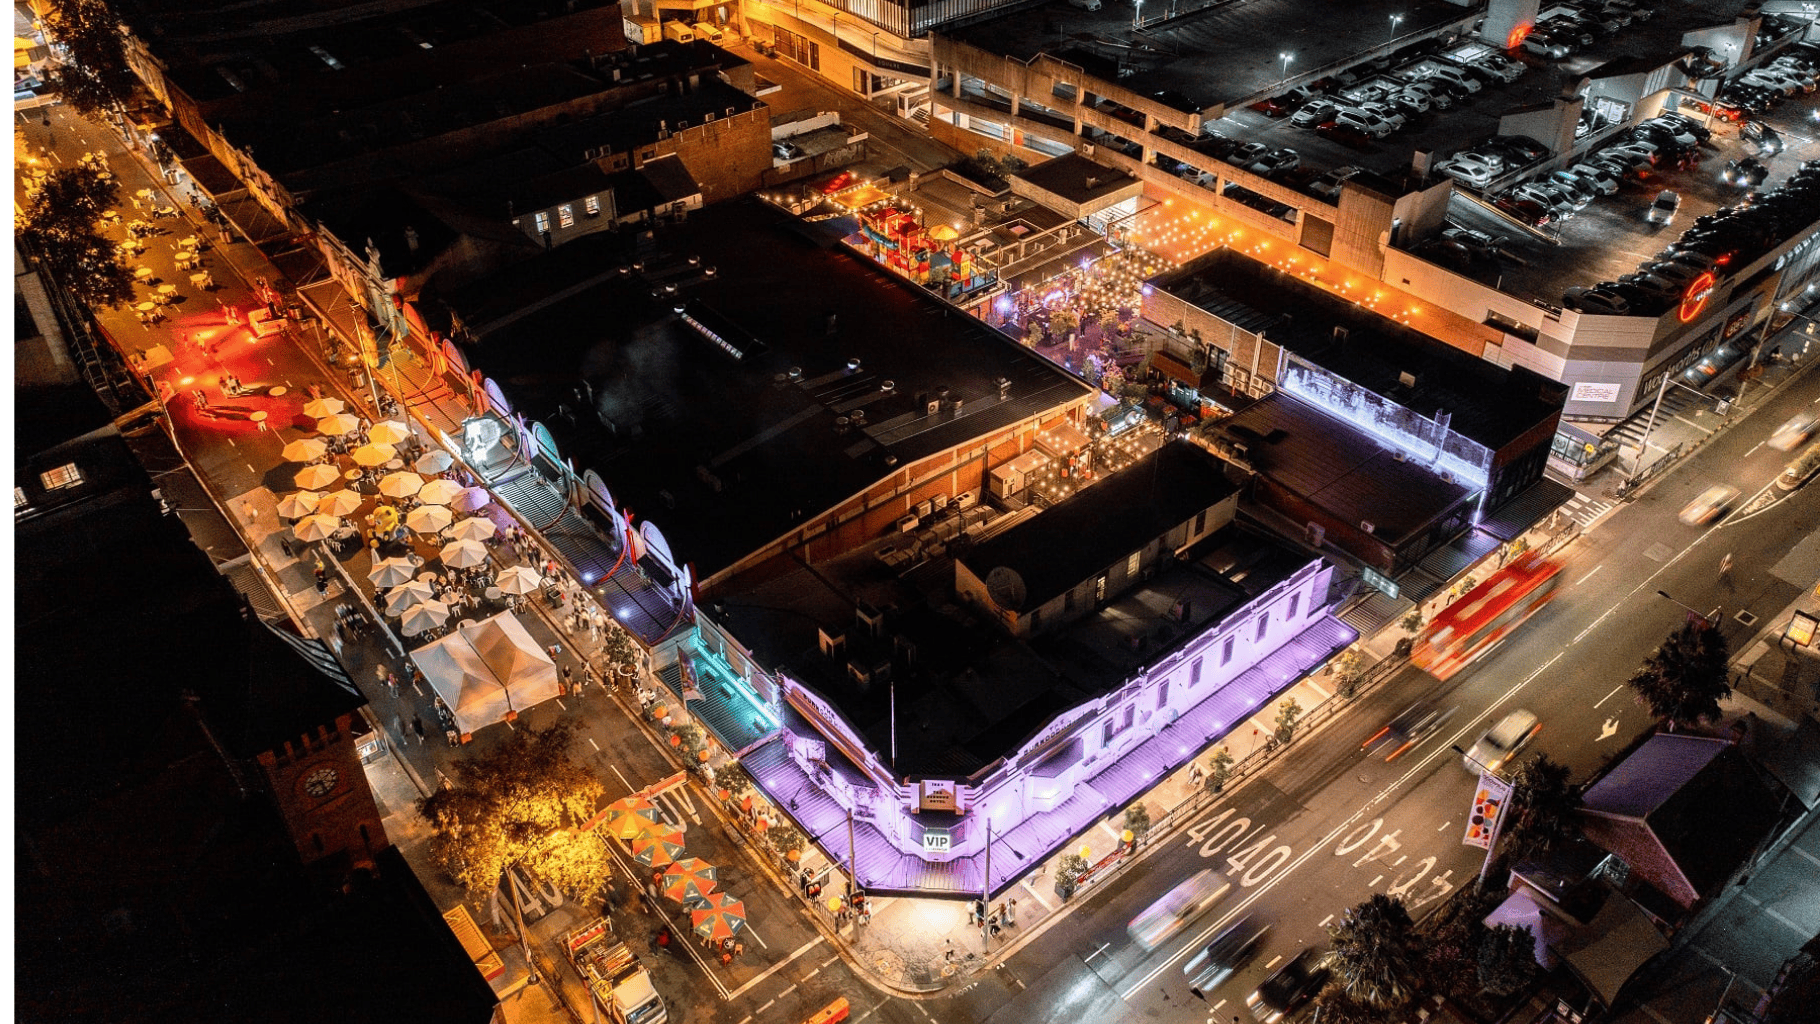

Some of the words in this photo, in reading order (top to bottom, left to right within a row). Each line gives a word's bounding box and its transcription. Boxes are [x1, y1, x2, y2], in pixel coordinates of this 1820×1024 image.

[926, 836, 948, 847] VIP
[1186, 808, 1251, 858] 40
[1226, 835, 1292, 886] 40
